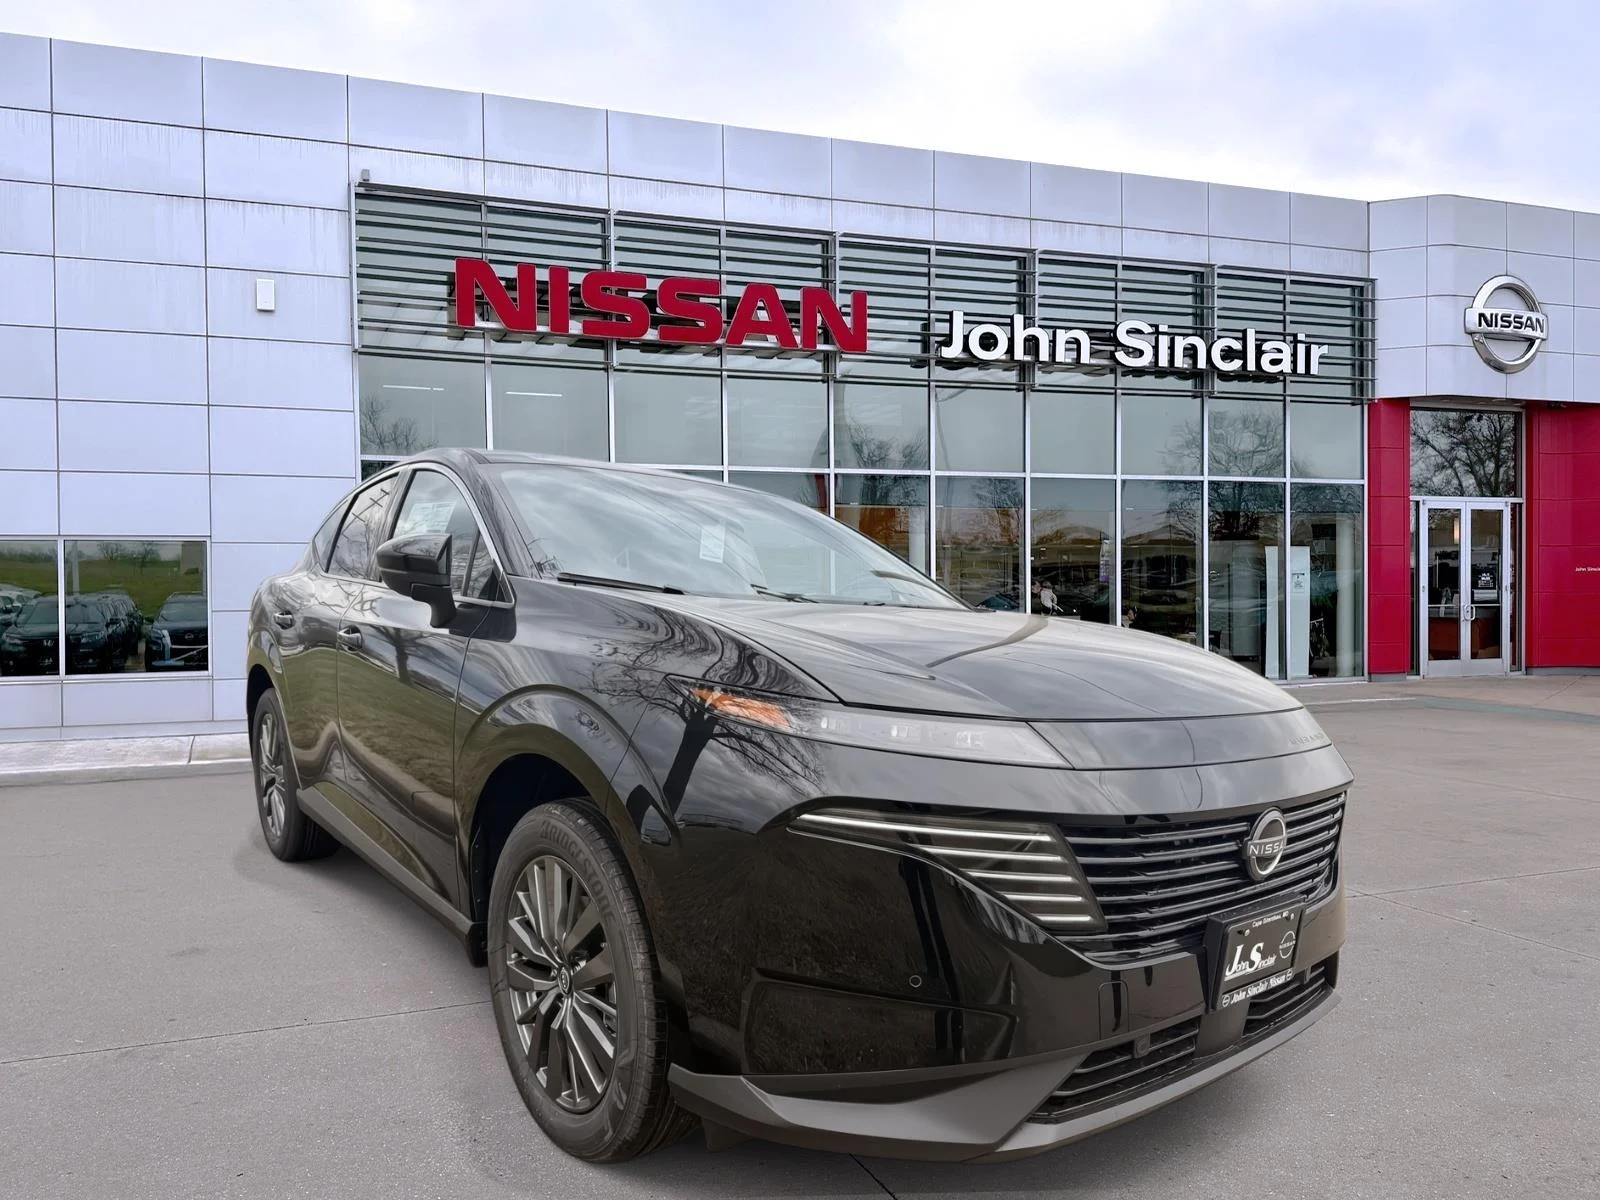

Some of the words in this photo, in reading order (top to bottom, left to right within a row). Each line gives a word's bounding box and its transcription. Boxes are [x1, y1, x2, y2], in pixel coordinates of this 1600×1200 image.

[455, 257, 868, 353] NISSAN
[1478, 312, 1544, 333] NISSAN
[941, 310, 1091, 363] John
[1114, 319, 1329, 375] Sinclair
